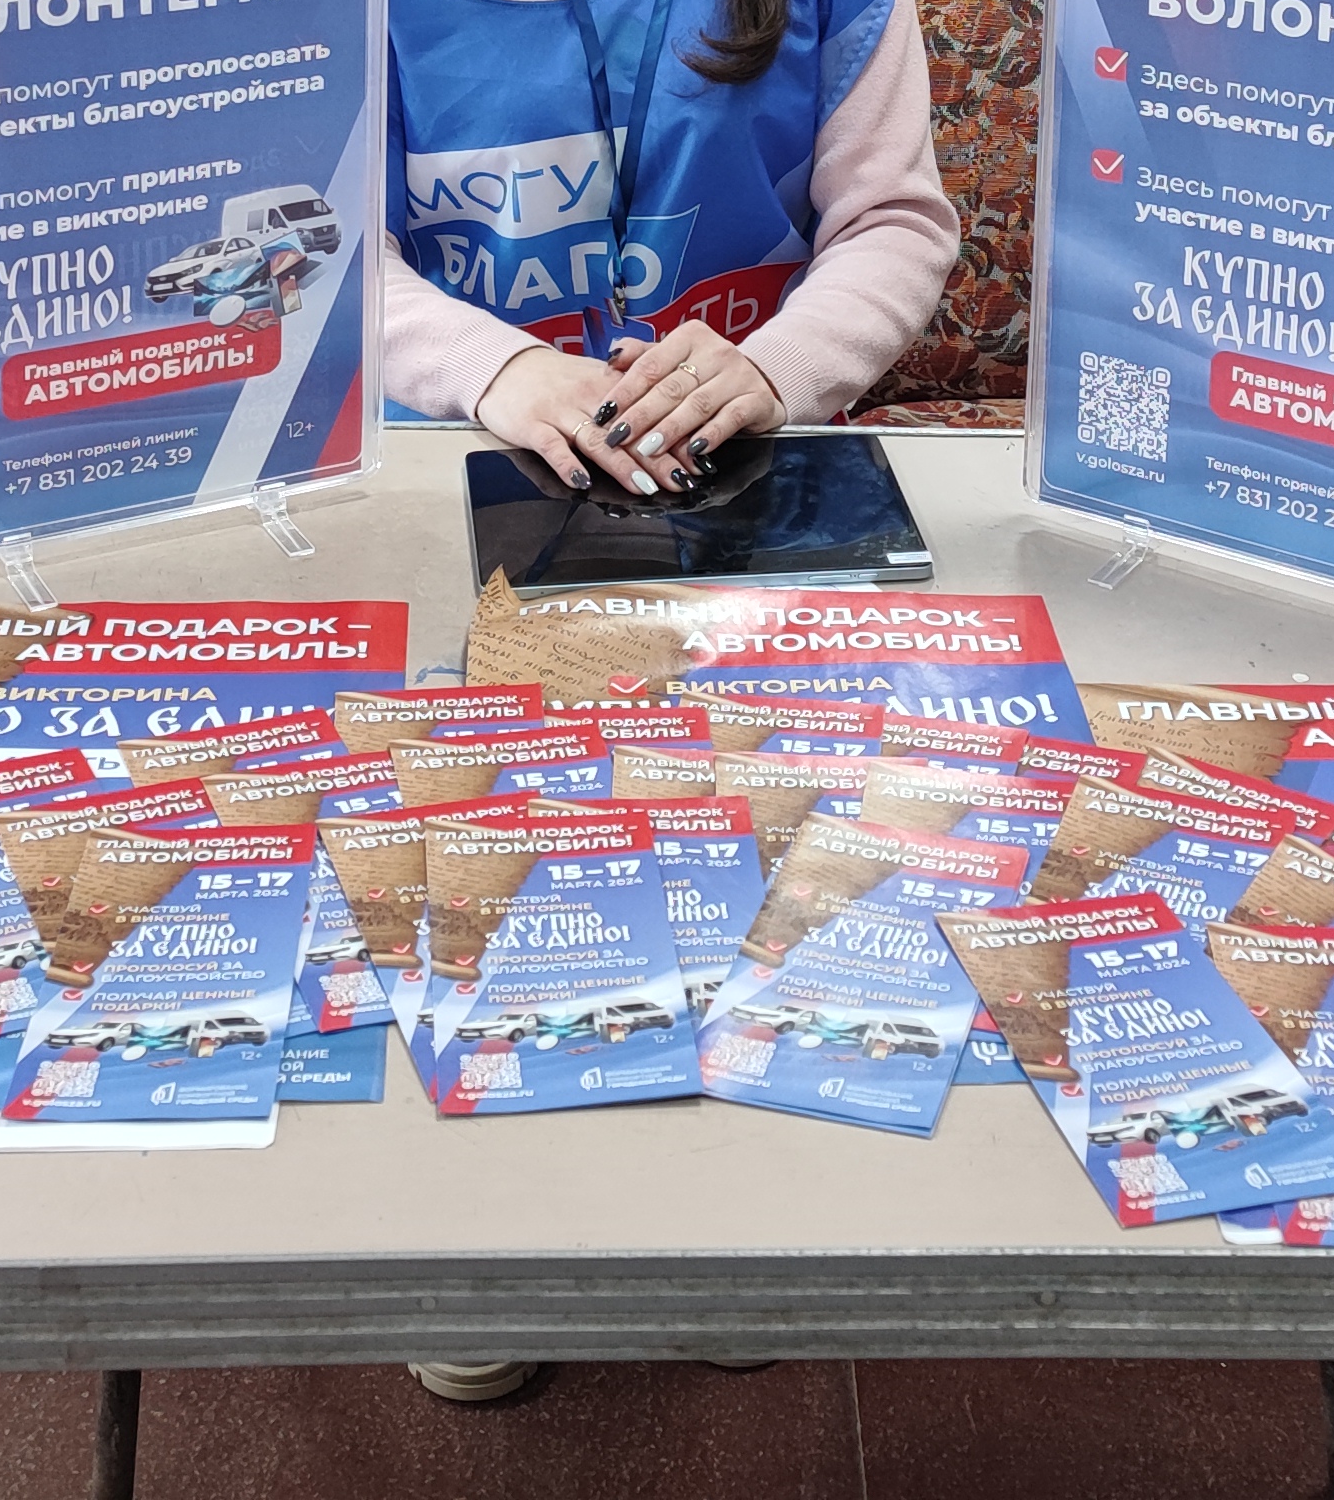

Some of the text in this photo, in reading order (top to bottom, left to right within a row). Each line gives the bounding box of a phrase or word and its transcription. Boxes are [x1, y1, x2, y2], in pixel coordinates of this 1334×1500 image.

[120, 42, 331, 92] проголосовать
[1141, 64, 1219, 96] Здесь
[84, 73, 325, 128] благоустройства
[1139, 100, 1169, 121] за
[1176, 101, 1299, 142] объекты
[122, 157, 242, 195] принять
[407, 161, 599, 222] МОГУ
[1136, 167, 1214, 200] Здесь
[1221, 185, 1332, 221] помогут
[33, 219, 49, 236] в
[56, 193, 209, 235] викторине
[1135, 202, 1243, 238] участие
[1250, 223, 1266, 241] в
[434, 234, 662, 309] БЛАГО
[1183, 246, 1325, 311] КУПНО
[1132, 280, 1182, 328] ЗА
[24, 330, 227, 381] Главный подарок
[24, 345, 254, 406] АВТОМОБИЛЬ!
[1231, 367, 1326, 403] Главный
[286, 420, 315, 439] 12+
[4, 427, 198, 473] Телефон горячей линии:
[4, 446, 192, 496] +7 831 202 24 39
[1076, 451, 1165, 484] v.golosza.ru
[1205, 456, 1270, 484] Телефон
[1204, 478, 1231, 499] +7
[1236, 484, 1270, 510] 831
[1276, 495, 1319, 523] 202
[519, 598, 981, 627] ГЛАВНЫЙ ПОДАРОК
[104, 617, 334, 639] ПОДАРОК
[683, 631, 1023, 654] АВТОМОБИЛЬ!
[14, 641, 369, 662] АВТОМОБИЛЬ!
[666, 675, 894, 694] ВИКТОРИНА
[44, 705, 120, 737] ЗА
[401, 736, 579, 758] ГЛАВНЫЙ ПОДАРОК
[411, 745, 588, 770] АВТОМОБИЛЬ!
[96, 836, 288, 849] ГЛАВНЫЙ ПОДАРОК
[435, 824, 624, 840] ГЛАВНЫЙ ПОДАРОК
[443, 835, 633, 855] АВТОМОБИЛЬ!
[99, 847, 292, 864] АВТОМОБИЛЬ!
[118, 904, 201, 914] УЧАСТВУЙ
[195, 889, 289, 900] МАРТА 2024
[131, 913, 229, 922] ВИКТОРИНЕ
[138, 923, 235, 942] КУПНО
[953, 907, 1142, 935] ГЛАВНЫЙ ПОДАРОК
[970, 916, 1158, 949] АВТОМОБИЛЬ!
[104, 962, 243, 973] ПРОГОЛОСУЙ ЗА
[91, 1002, 181, 1012] ПОДАРКИ!
[94, 990, 256, 1001] ПОЛУЧАЙ ЦЕННЫЕ
